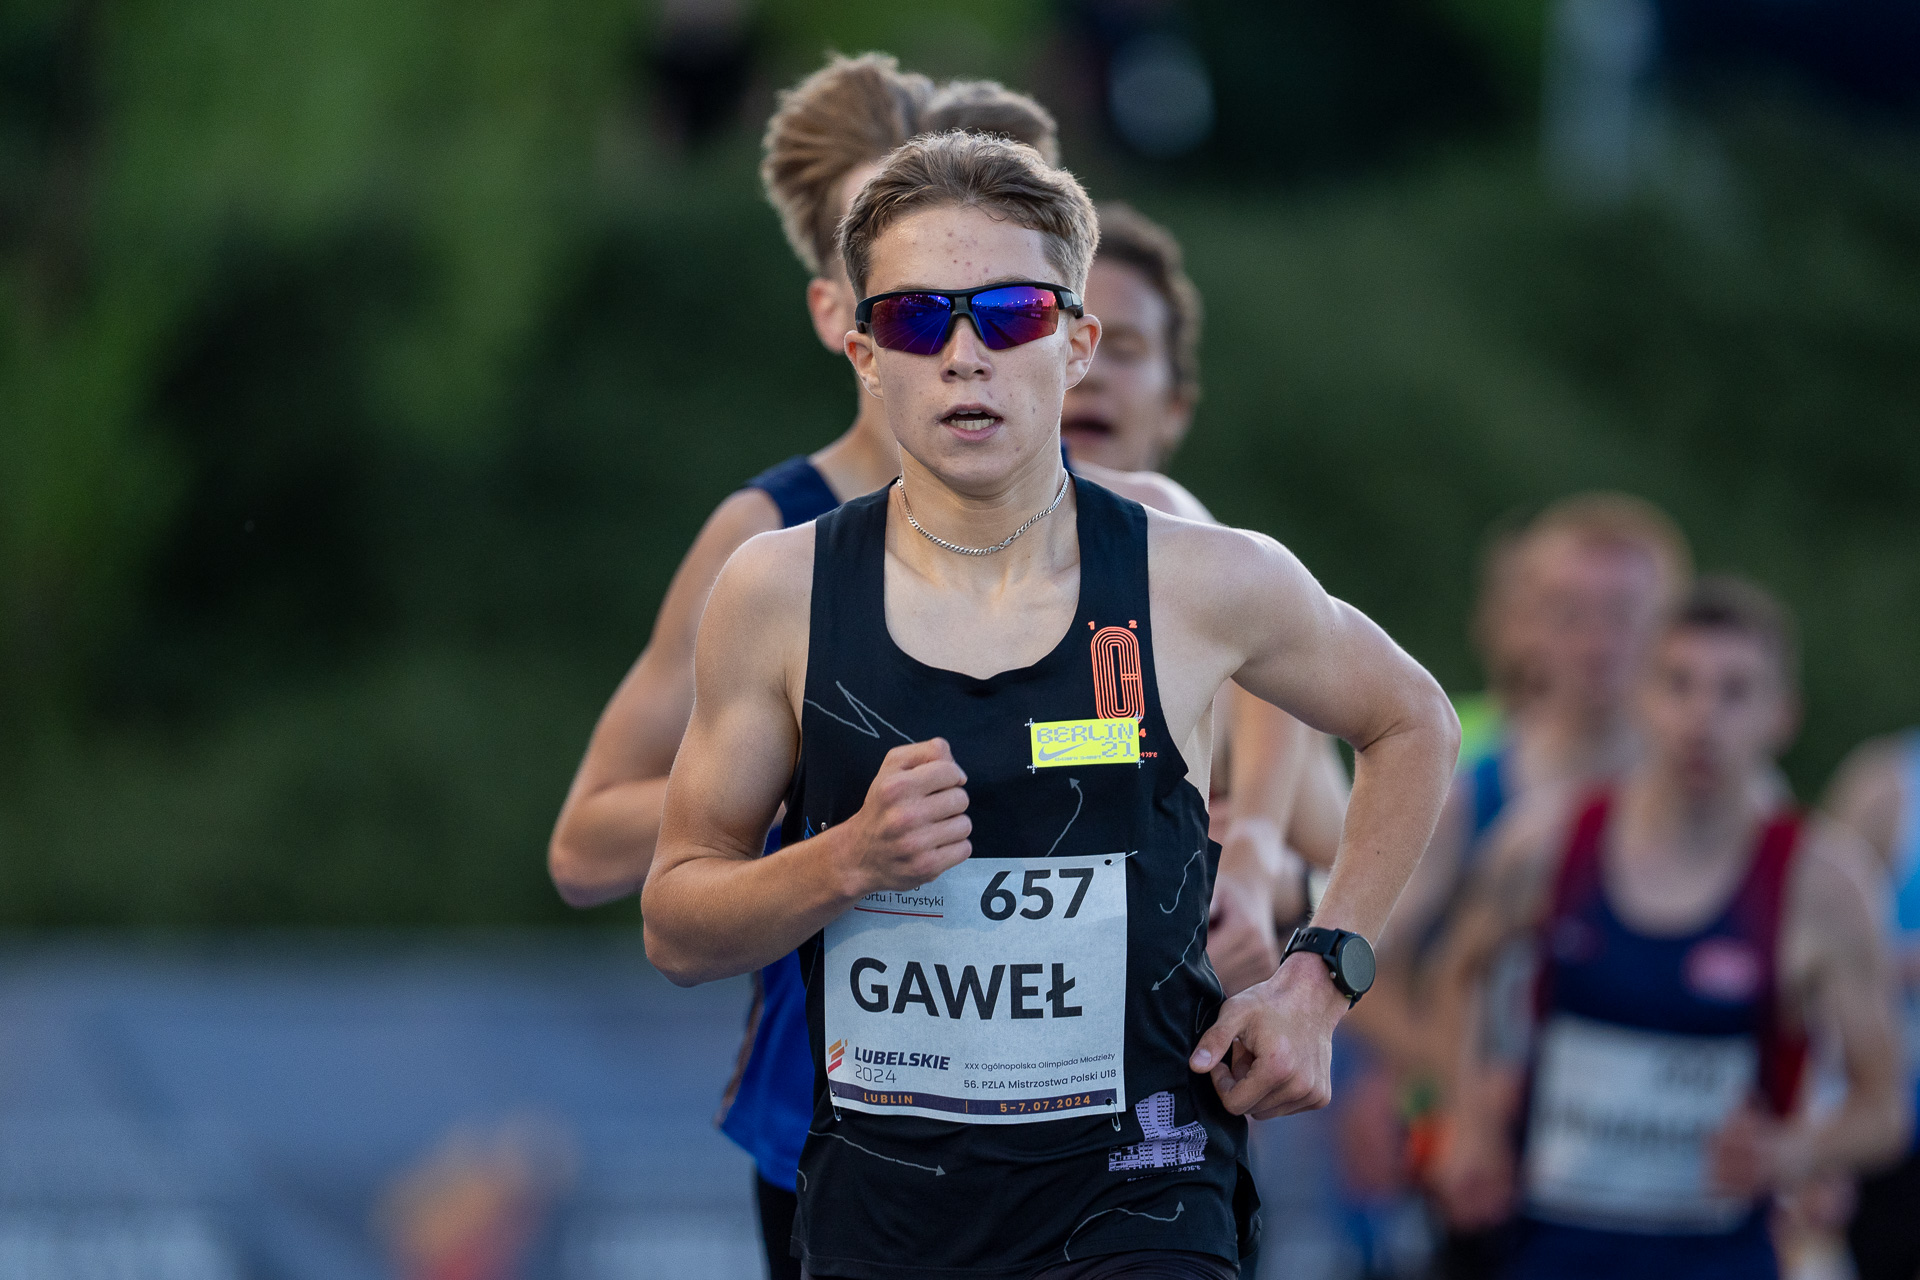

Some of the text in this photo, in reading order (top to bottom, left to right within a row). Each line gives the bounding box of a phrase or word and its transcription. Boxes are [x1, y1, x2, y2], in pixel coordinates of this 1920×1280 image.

[1087, 620, 1138, 631] 1 2
[1036, 723, 1134, 744] BERLIN
[1101, 740, 1135, 758] 21
[861, 892, 886, 903] ortu
[895, 893, 944, 908] Turystyki
[980, 867, 1094, 921] 657
[850, 957, 1083, 1020] GAWEŁ
[854, 1046, 951, 1071] LUBELSKIE
[964, 1053, 1116, 1072] XXX Ogólnopolska Olimpiada Młodzieży
[855, 1063, 897, 1084] 2024
[963, 1069, 1117, 1090] 56. PZLA Mistrzostwa Polski U18
[863, 1092, 914, 1105] LUBLIN
[1000, 1095, 1091, 1113] 5-7.07.2024
